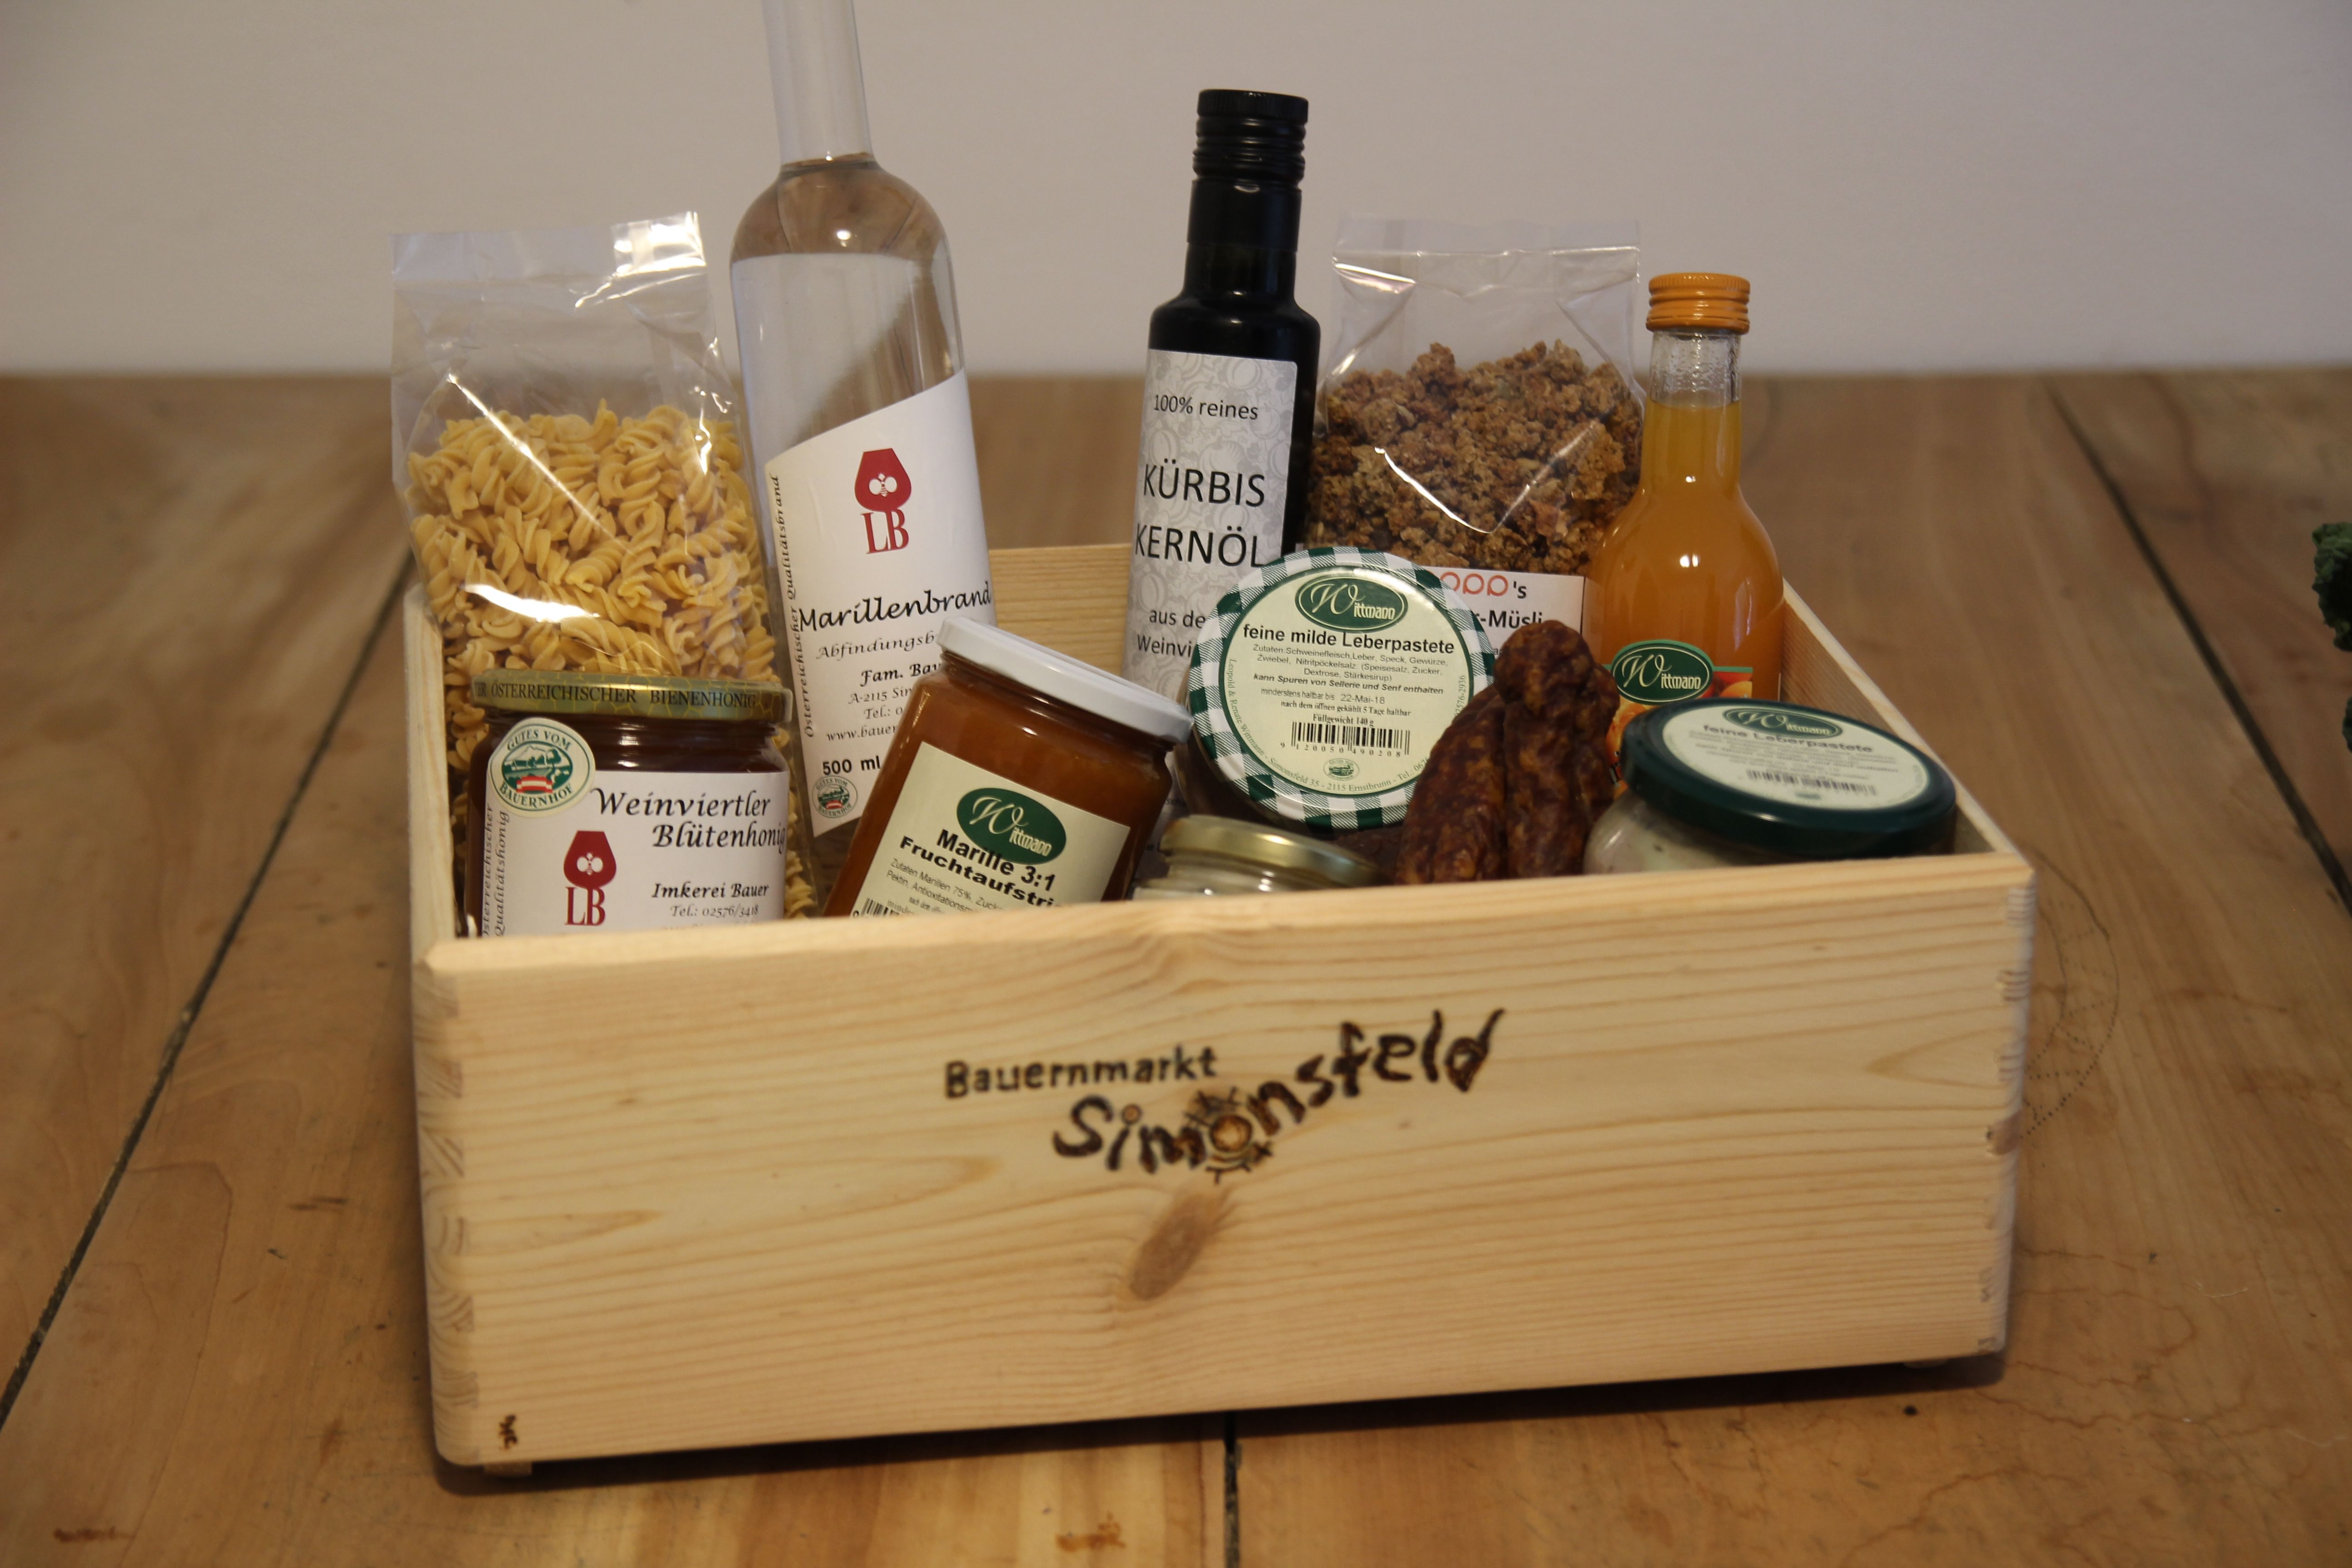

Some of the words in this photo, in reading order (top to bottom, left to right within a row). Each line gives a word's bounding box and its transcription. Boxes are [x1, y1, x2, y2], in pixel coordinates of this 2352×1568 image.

[1153, 394, 1193, 415] 100%
[1199, 398, 1259, 421] reines
[1143, 458, 1266, 507] KÜRBIS
[769, 475, 796, 600] Qualitätsbrand
[861, 508, 909, 554] LB
[1135, 523, 1267, 568] KERNÖL
[799, 581, 992, 632] Marillenbrand
[1310, 583, 1396, 620] Wittmann
[1149, 610, 1176, 626] aus
[816, 631, 936, 661] Abfindungsb
[1137, 634, 1192, 657] Weinvi
[1243, 623, 1285, 641] feine
[1291, 630, 1337, 645] milde
[1343, 632, 1454, 654] Leberpastete
[789, 607, 814, 738] Österreichischer
[860, 669, 903, 687] Fam.
[1226, 659, 1236, 688] Leopold
[1254, 673, 1274, 681] kann
[1278, 676, 1308, 685] Spuren
[1329, 680, 1360, 689] Sellerie
[1403, 686, 1444, 694] enthalten
[1622, 655, 1701, 690] Wittmann
[491, 679, 637, 703] ÖSTERREICHISCHER
[651, 690, 756, 708] BIENENHONIG
[848, 692, 887, 705] A-2115
[1340, 694, 1385, 704] 22-Mai-18
[1230, 700, 1242, 724] Renate
[1313, 714, 1353, 725] Füllgewicht
[1337, 705, 1362, 713] gekühlt
[1369, 707, 1384, 715] Tage
[1387, 708, 1411, 717] haltbar
[507, 729, 539, 750] GUTES
[544, 730, 571, 750] VOM
[1241, 724, 1264, 756] Wittmann
[823, 759, 852, 775] 500
[860, 755, 881, 771] ml
[1269, 758, 1308, 784] Simonsfeld
[500, 781, 572, 808] BAUERNHOF
[1309, 779, 1320, 787] 35
[1327, 783, 1346, 792] 2115
[590, 788, 771, 817] Weinviertler
[652, 820, 785, 854] Blütenhonig
[969, 795, 1053, 857] Wittmann
[494, 811, 510, 937] Qualitätshonig
[900, 835, 1057, 906] Fruchtaufstri
[936, 828, 1014, 876] Marille
[1021, 865, 1056, 892] 3:1
[651, 881, 726, 898] Imkerei
[730, 883, 769, 898] Bauer
[565, 886, 606, 925] LB
[945, 1044, 1218, 1098] Bauernmarkt
[1052, 1008, 1505, 1178] Simonsfeld
